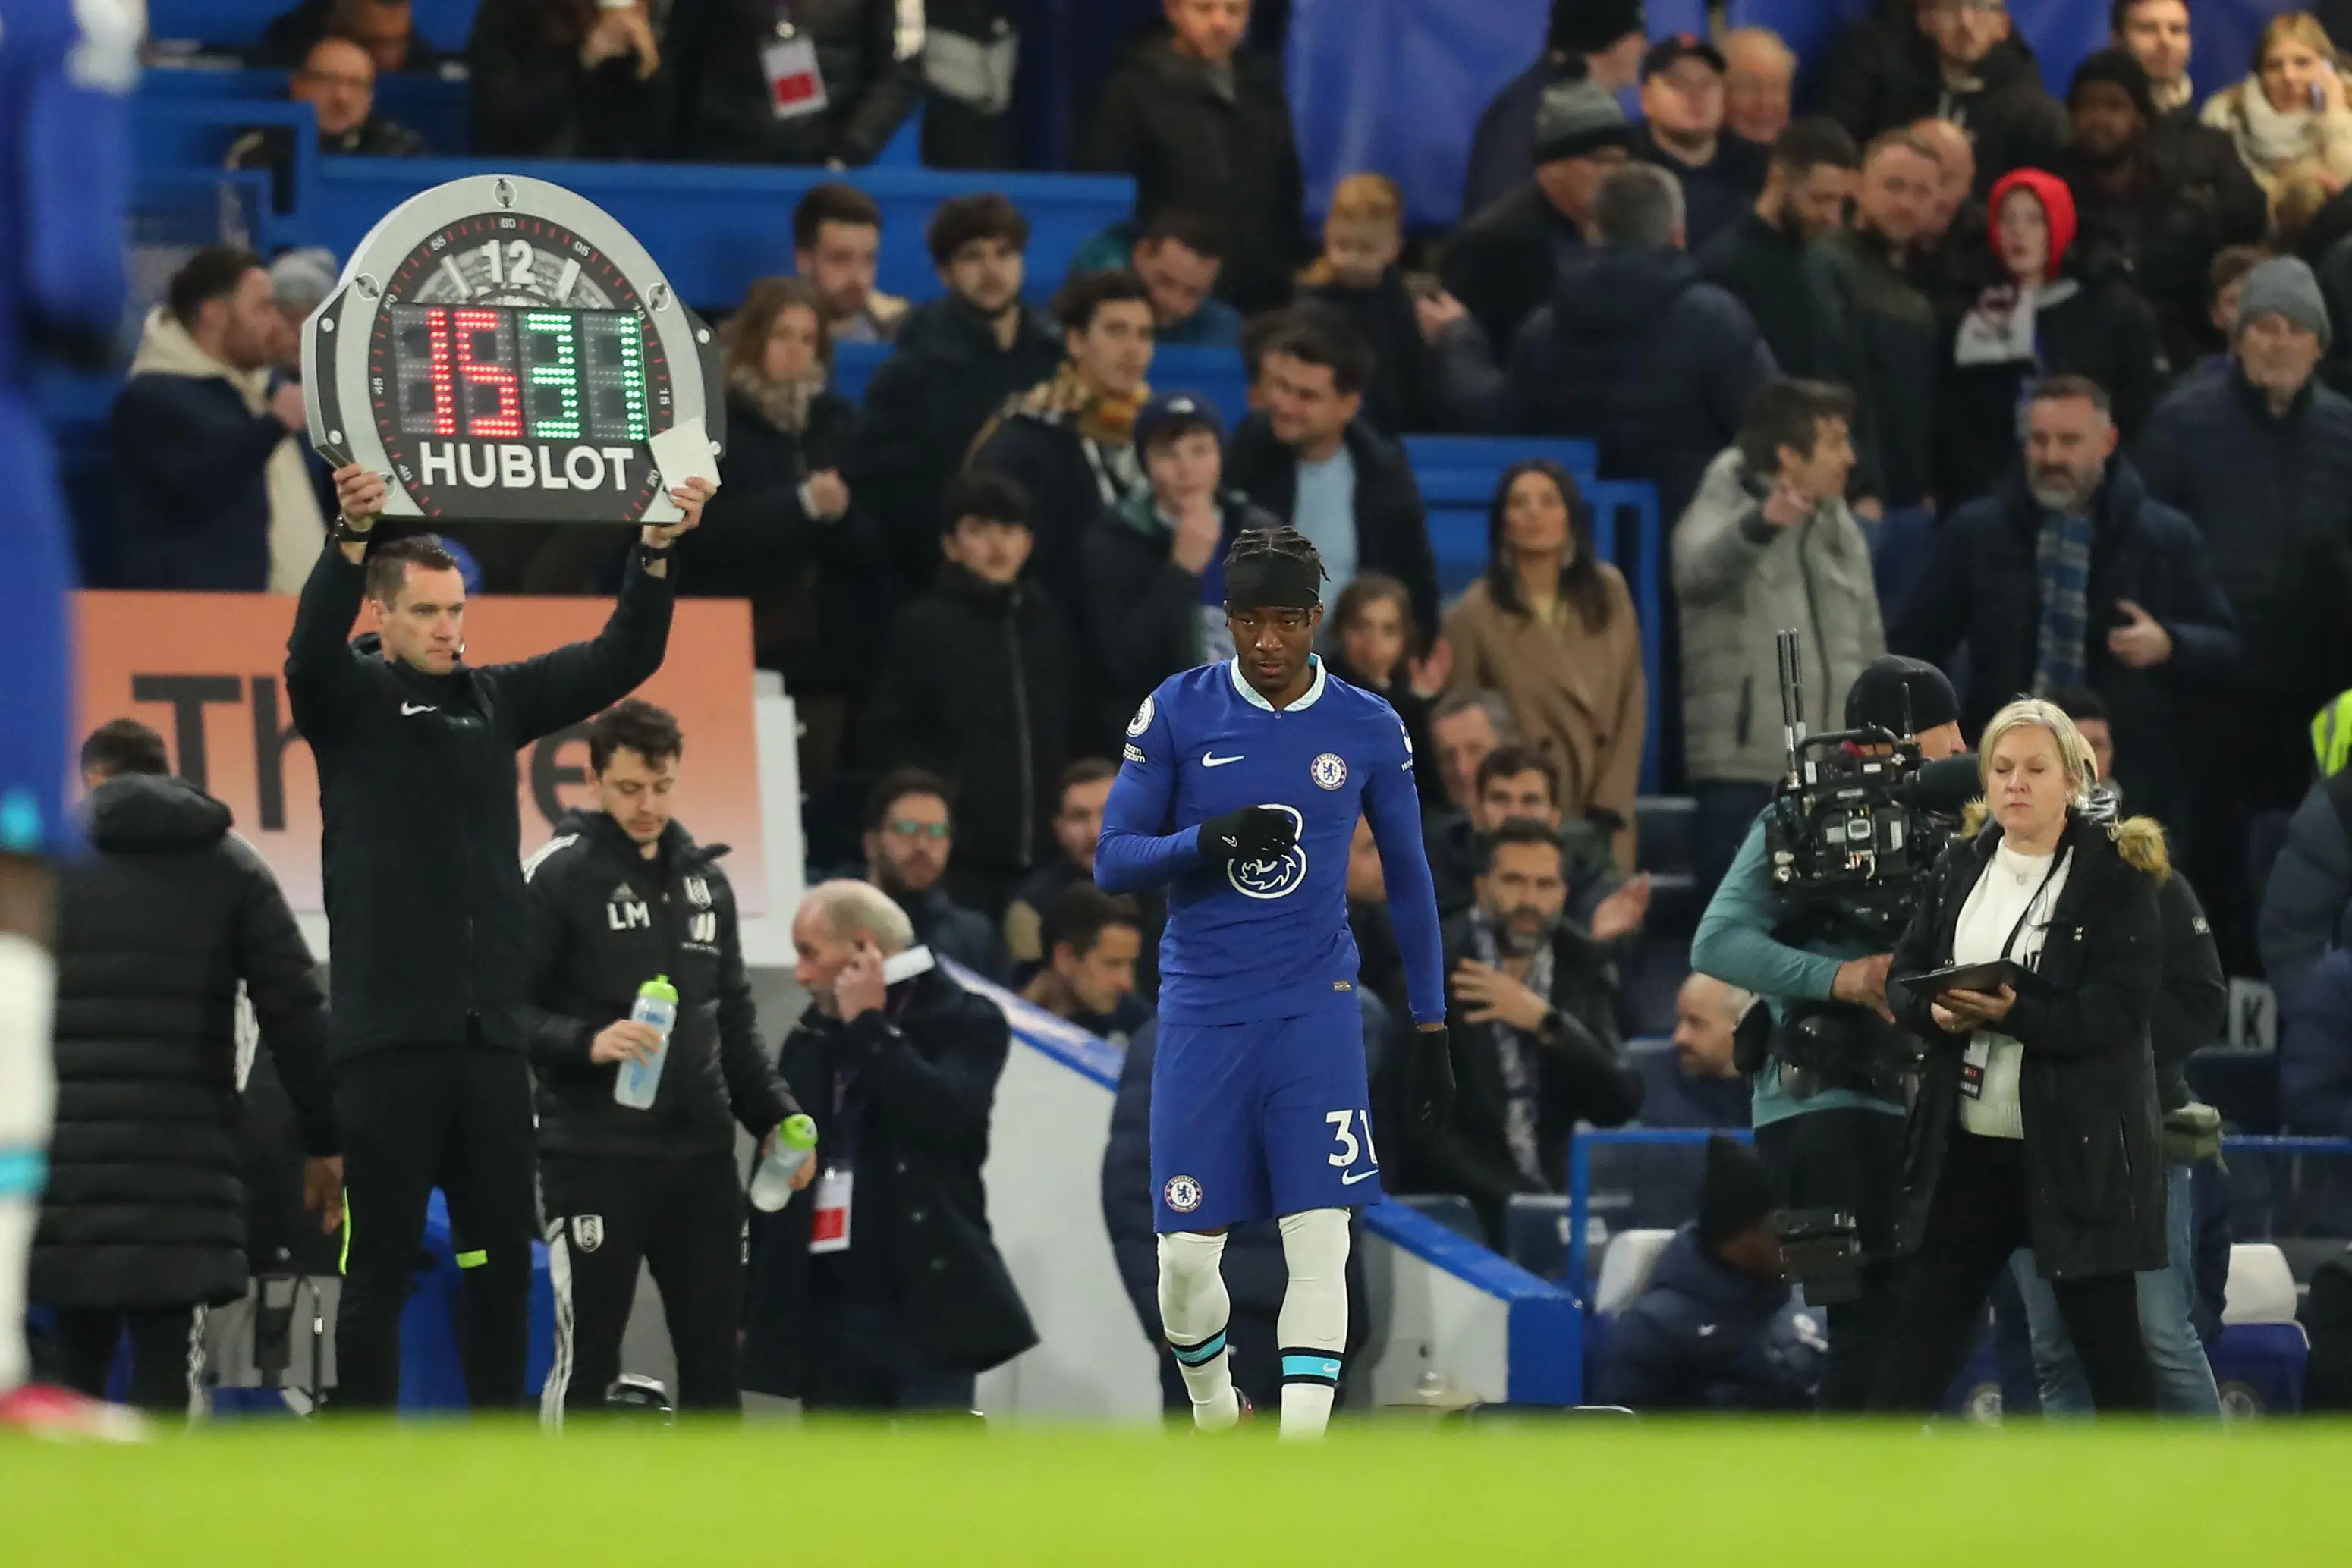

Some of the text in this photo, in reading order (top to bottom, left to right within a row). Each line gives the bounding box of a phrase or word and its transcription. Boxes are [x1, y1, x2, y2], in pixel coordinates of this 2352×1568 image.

[501, 218, 517, 229] 60
[430, 234, 447, 251] 55
[575, 240, 591, 256] 05
[480, 239, 536, 284] 12
[428, 309, 646, 441] 15 31
[659, 388, 671, 405] 15
[398, 464, 413, 482] 40
[420, 441, 634, 491] HUBLOT
[608, 901, 651, 930] LM
[1325, 1109, 1379, 1167] 31
